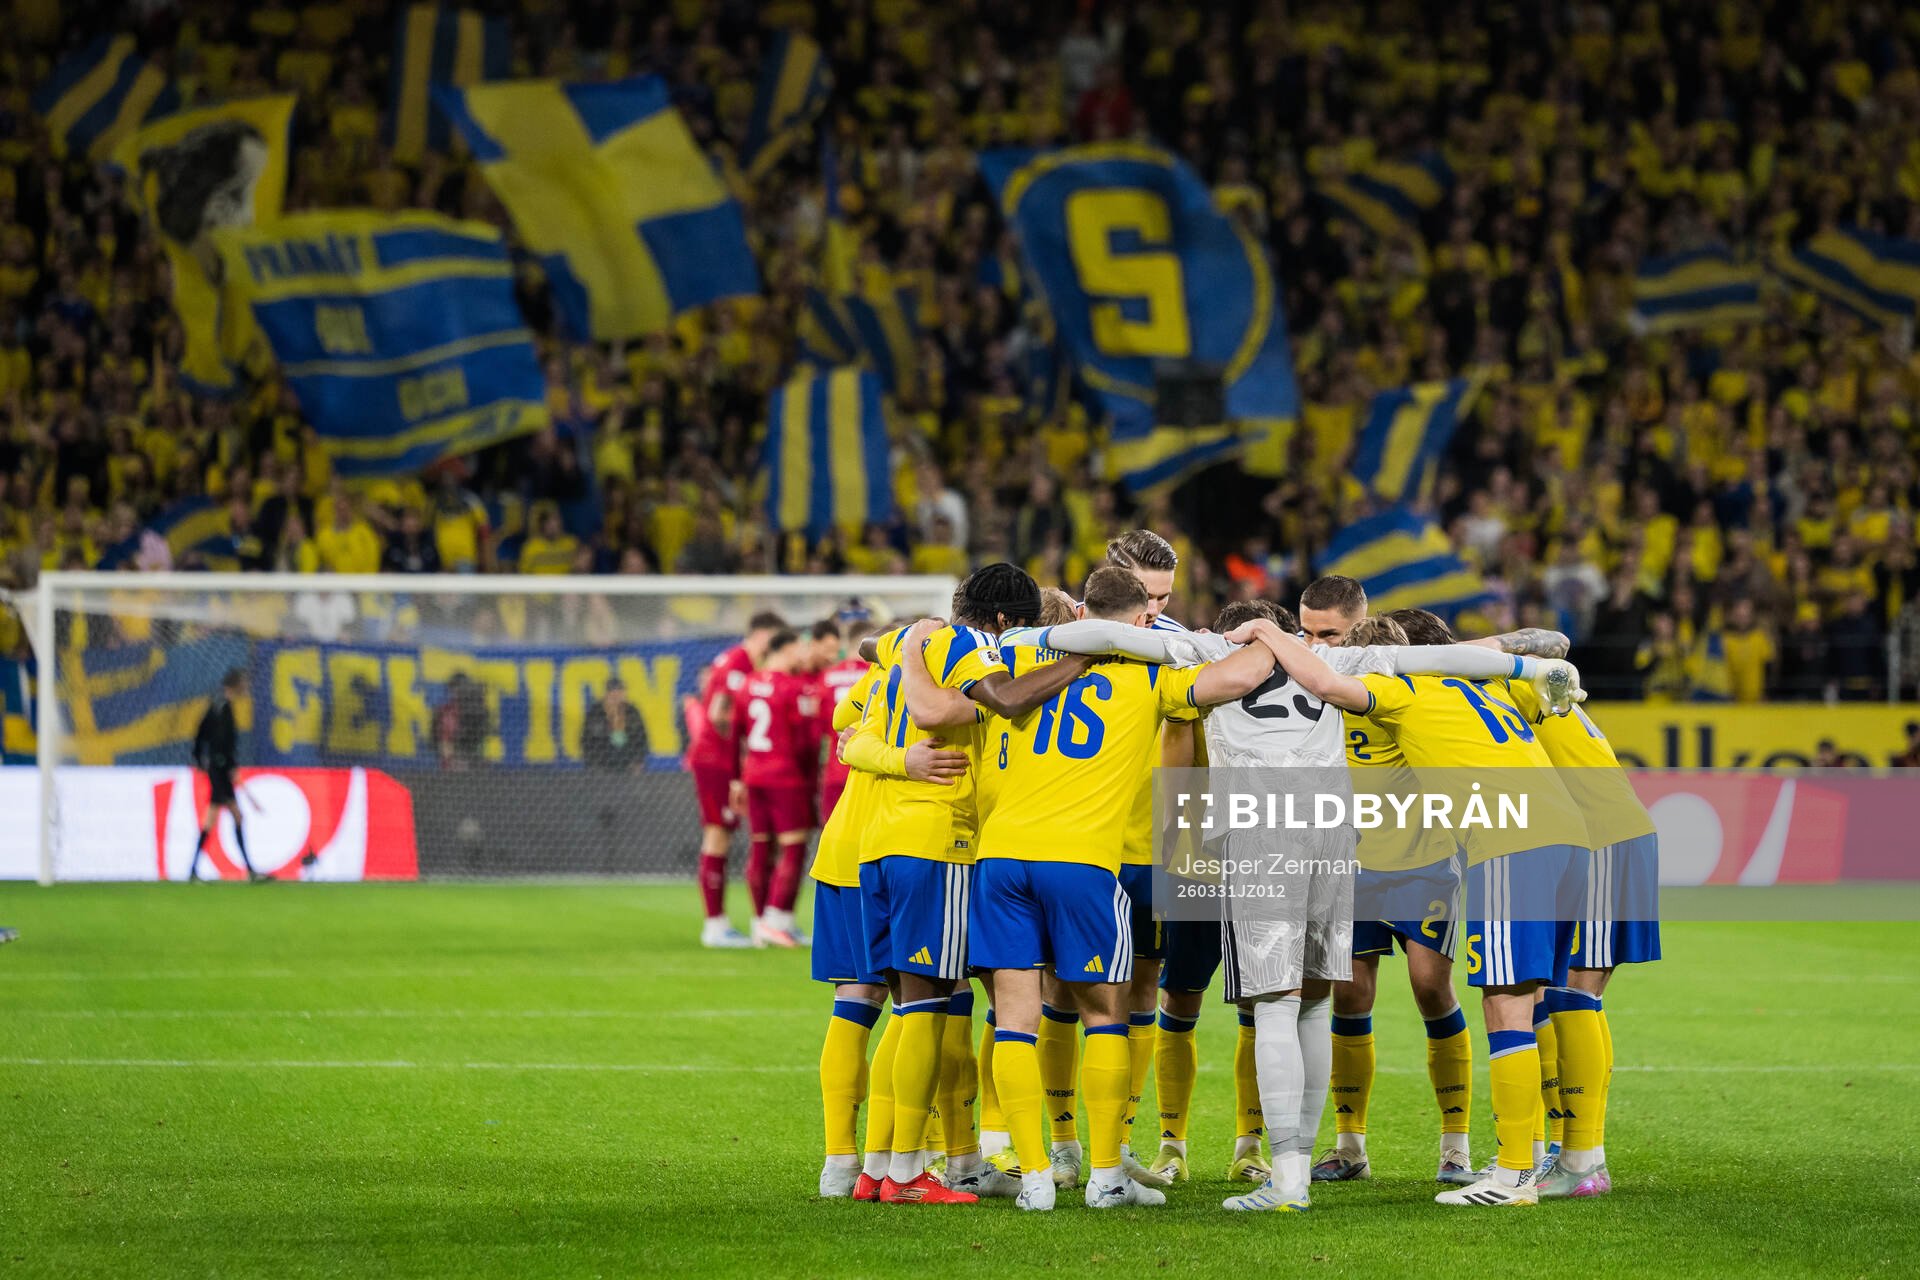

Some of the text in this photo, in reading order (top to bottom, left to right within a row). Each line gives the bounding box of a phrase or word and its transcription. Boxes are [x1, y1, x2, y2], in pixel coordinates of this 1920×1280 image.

[748, 699, 773, 752] 2
[1033, 672, 1112, 759] 16
[1350, 730, 1372, 760] 2
[1420, 899, 1447, 939] 2
